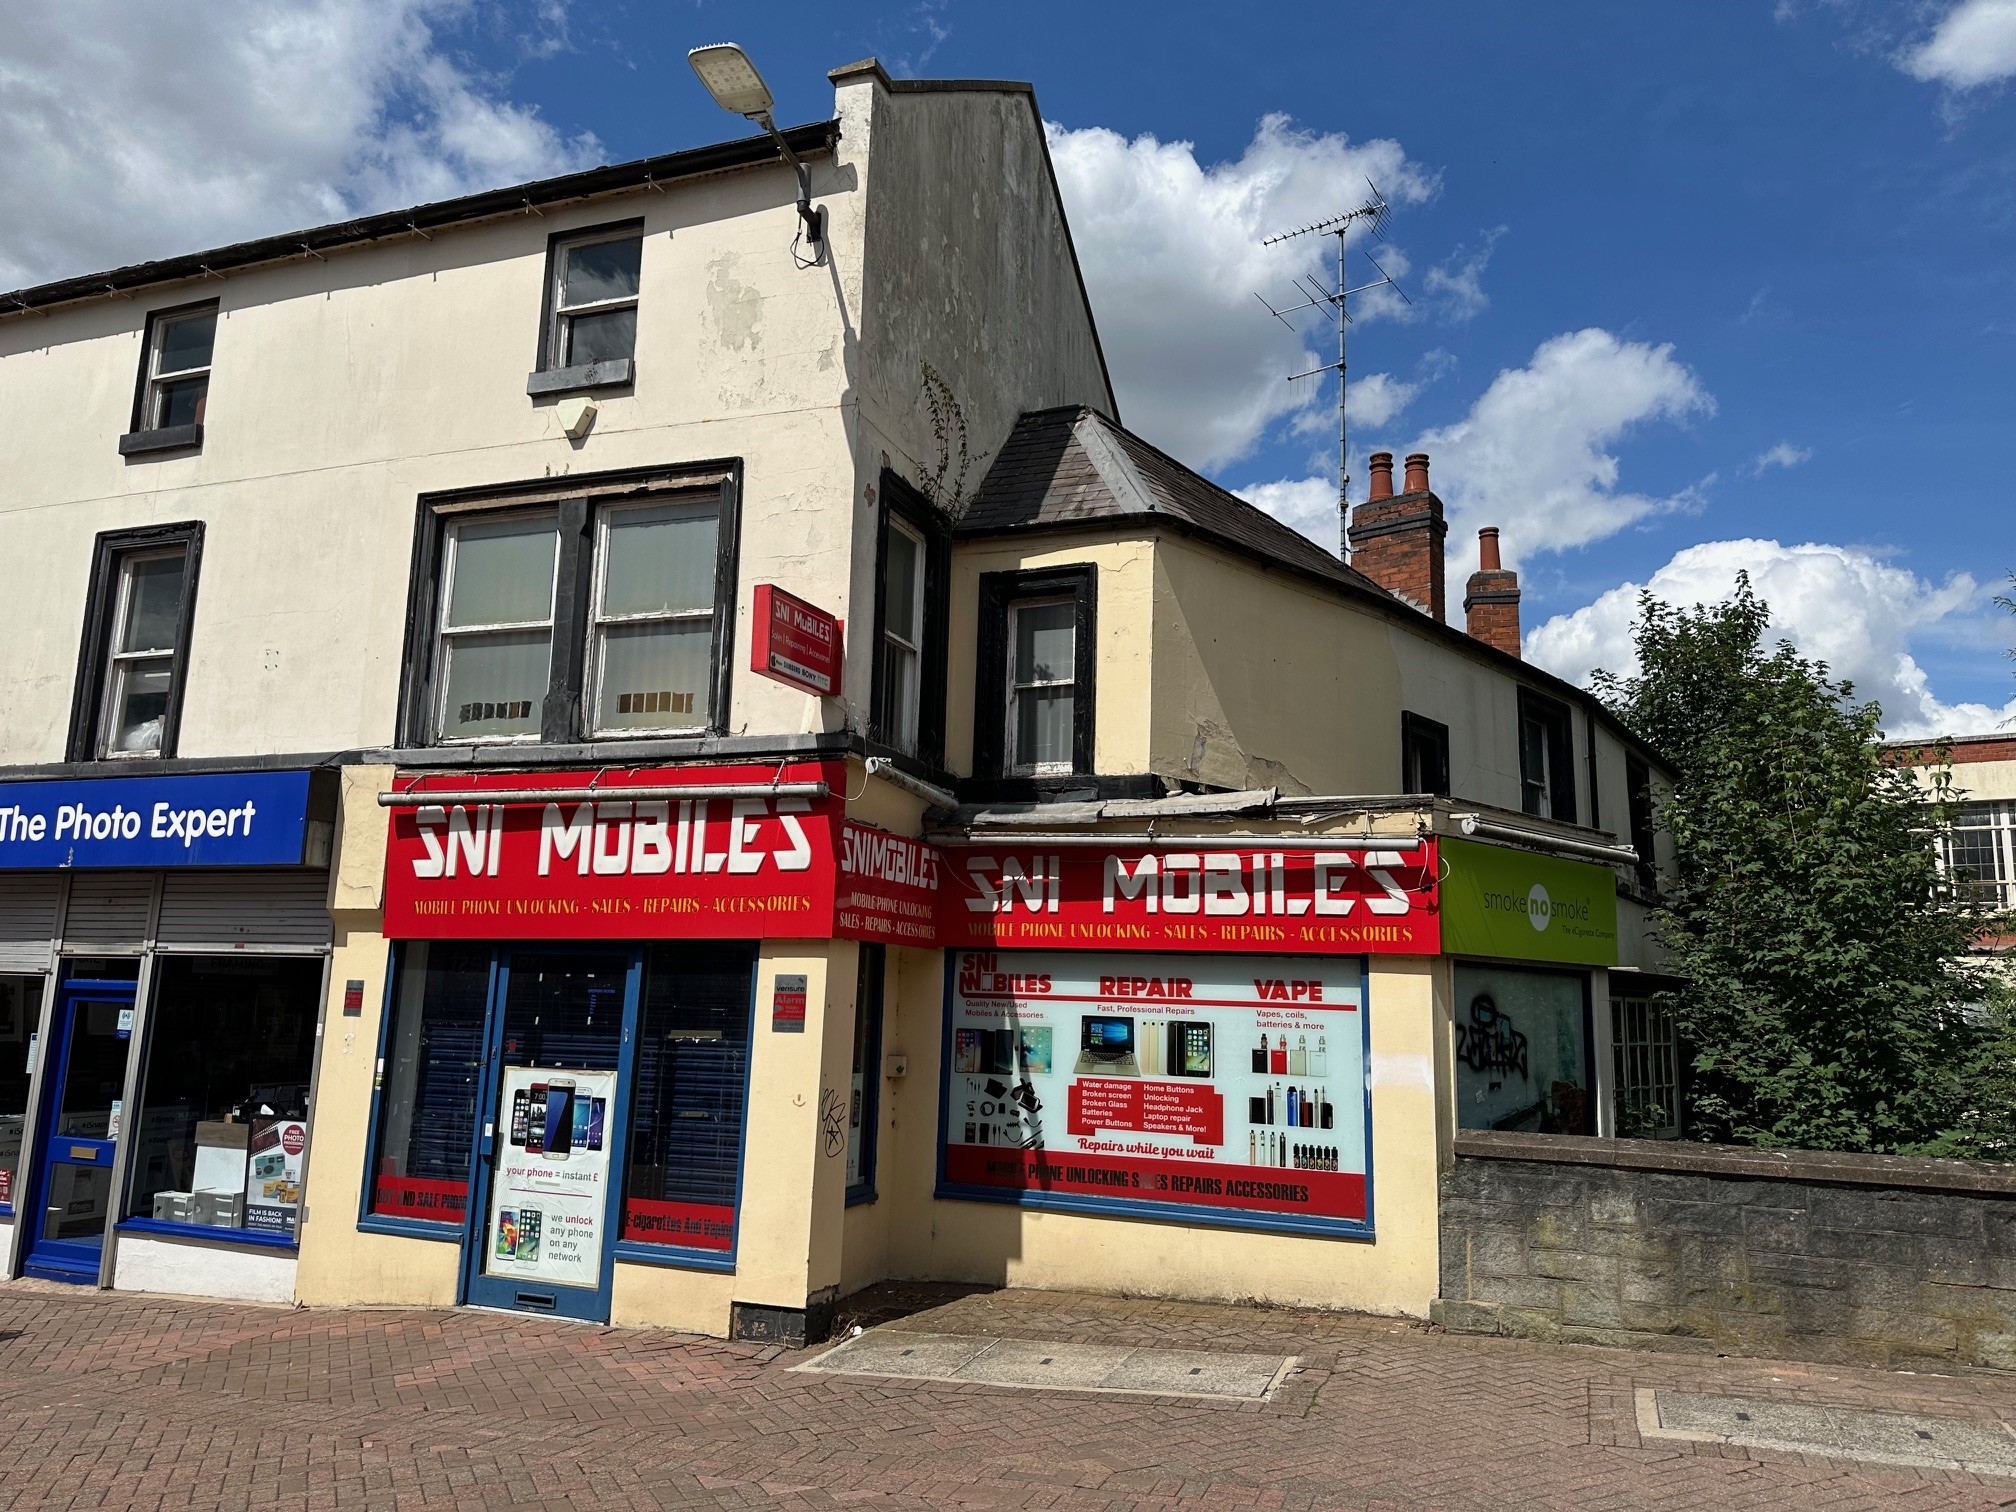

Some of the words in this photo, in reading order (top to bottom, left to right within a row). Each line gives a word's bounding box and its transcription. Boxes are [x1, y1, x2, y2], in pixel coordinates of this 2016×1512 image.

[774, 600, 790, 623] SNI
[794, 609, 830, 642] MOBILES
[801, 669, 817, 681] SONY
[0, 804, 46, 842] The
[54, 802, 141, 841] Photo
[151, 800, 256, 848] Expert
[412, 803, 505, 879] SNI
[537, 797, 813, 876] MOBILES
[964, 854, 1062, 914] SNI
[1102, 850, 1412, 917] MOBILES
[414, 900, 457, 914] MOBILE
[461, 899, 502, 914] PHONE
[507, 898, 580, 914] UNLOCKING
[591, 896, 631, 914] SALES
[643, 896, 700, 914] REPAIRS
[712, 894, 811, 913] ACCESSORIES
[850, 891, 876, 910] MOBILE
[876, 896, 898, 915] PHONE
[899, 900, 933, 920] UNLOCKING
[1484, 889, 1527, 914] smoke
[1529, 897, 1549, 917] no
[839, 911, 861, 930] SALES
[864, 915, 892, 934] REPAIRS
[895, 920, 936, 940] ACCESSORIES
[1561, 924, 1572, 935] The
[968, 921, 1016, 937] MOBILE
[1019, 922, 1066, 938] PHONE
[1069, 922, 1151, 939] UNLOCKING
[1163, 923, 1208, 940] SALES
[1220, 924, 1286, 941] REPAIRS
[1299, 924, 1414, 943] ACCESSORIES
[962, 953, 998, 973] SNI
[1099, 975, 1193, 998] REPAIR
[1253, 979, 1323, 1002] VAPE
[775, 995, 804, 1004] Alarm
[965, 999, 990, 1009] Quality
[991, 1000, 1028, 1009] New/Used
[965, 1009, 992, 1017] Mobiles
[1000, 1010, 1044, 1019] Accessories
[1096, 1004, 1115, 1013] Fast,
[1116, 1004, 1165, 1014] Professional
[1166, 1006, 1195, 1016] Repairs
[1256, 1009, 1283, 1019] Vapes,
[1285, 1011, 1308, 1020] coils,
[1256, 1020, 1293, 1029] batteries
[1294, 1021, 1301, 1029] &
[1302, 1022, 1325, 1031] more
[1082, 1080, 1103, 1088] Water
[1104, 1081, 1132, 1091] damage
[1143, 1084, 1165, 1092] Home
[1166, 1085, 1195, 1094] Buttons
[1082, 1090, 1107, 1098] Broken
[1143, 1094, 1179, 1103] Unlocking
[1082, 1099, 1107, 1107] Broken
[1108, 1100, 1128, 1109] Glass
[1143, 1103, 1184, 1113] Headphone
[1185, 1105, 1204, 1113] Jack
[1082, 1108, 1113, 1117] Batteries
[1143, 1112, 1168, 1122] Laptop
[1081, 1118, 1103, 1126] Power
[1105, 1119, 1133, 1128] Buttons
[1143, 1122, 1177, 1131] Speakers
[1185, 1125, 1207, 1133] More!
[284, 1134, 304, 1142] PHOTO
[1077, 1138, 1125, 1153] Repairs
[1126, 1142, 1160, 1155] while
[1161, 1148, 1185, 1159] you
[1186, 1147, 1215, 1160] wait
[506, 1167, 526, 1177] your
[527, 1167, 553, 1178] phone
[562, 1170, 592, 1182] instant
[593, 1172, 599, 1182] £
[1028, 1163, 1064, 1182] PHONE
[1066, 1166, 1128, 1188] UNLOCKING
[1171, 1174, 1222, 1195] REPAIRS
[1225, 1179, 1309, 1203] ACCESSORIES
[248, 1214, 255, 1222] IN
[255, 1215, 283, 1224] FASHION!
[551, 1214, 563, 1223] we
[565, 1215, 594, 1226] unlock
[549, 1226, 565, 1238] any
[567, 1228, 594, 1239] phone
[549, 1240, 560, 1248] on
[562, 1240, 578, 1250] any
[548, 1252, 582, 1263] network
